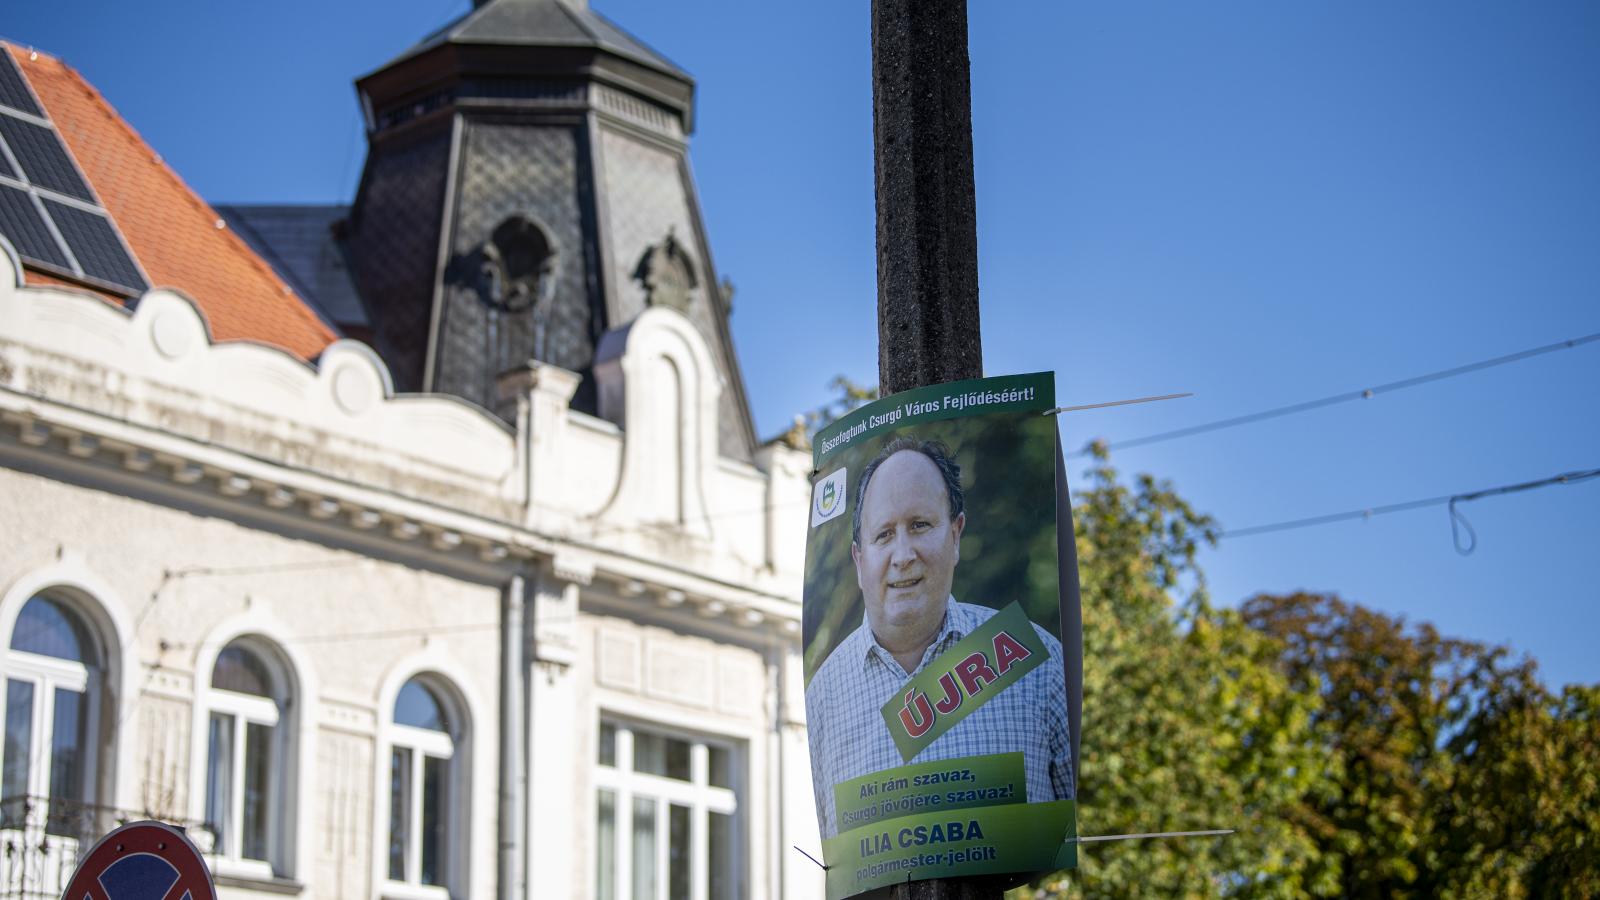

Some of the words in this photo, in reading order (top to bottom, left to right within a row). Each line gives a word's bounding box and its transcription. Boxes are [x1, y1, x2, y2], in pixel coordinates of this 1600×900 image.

[821, 418, 867, 454] Összefogtunk
[869, 403, 902, 429] Csurgó
[905, 398, 940, 417] Város
[943, 386, 1035, 411] Fejlődéséért!
[898, 631, 1032, 738] ÚJRA
[842, 804, 877, 825] Csurgó
[880, 793, 941, 815] jövőjére
[946, 783, 1014, 801] szavaz!
[860, 782, 878, 799] Aki
[881, 776, 909, 793] rám
[913, 769, 976, 787] szavaz,
[860, 831, 892, 858] ILIA
[898, 820, 984, 848] CSABA
[856, 846, 996, 882] polgármester-jelölt
